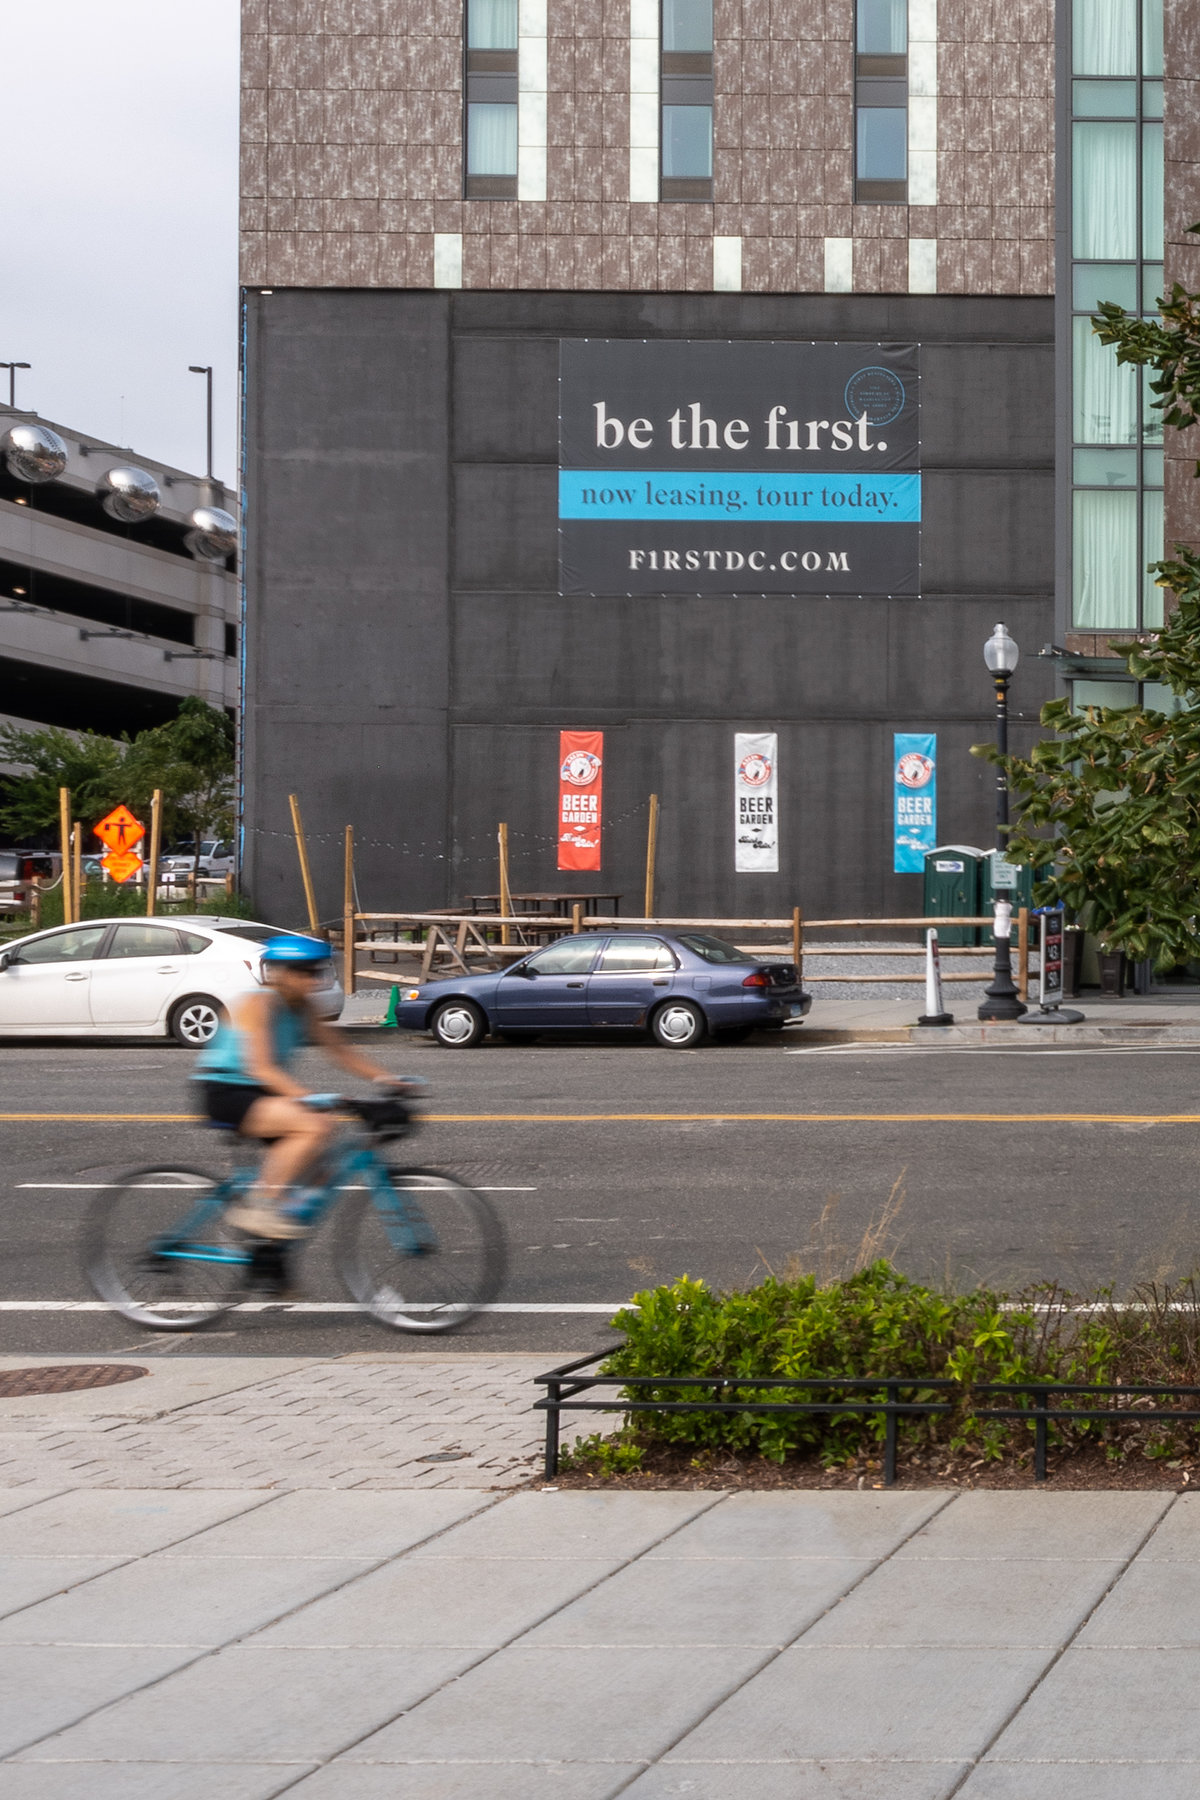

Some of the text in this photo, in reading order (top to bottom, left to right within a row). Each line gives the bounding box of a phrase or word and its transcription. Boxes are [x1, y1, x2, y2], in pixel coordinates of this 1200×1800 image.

[592, 401, 654, 449] be
[667, 402, 750, 450] the
[582, 481, 899, 514] now leasing. tour today.
[562, 794, 598, 812] BEER
[739, 797, 774, 813] BEER
[897, 796, 932, 813] BEER
[561, 811, 598, 824] GARDEN
[739, 814, 774, 825] GARDEN
